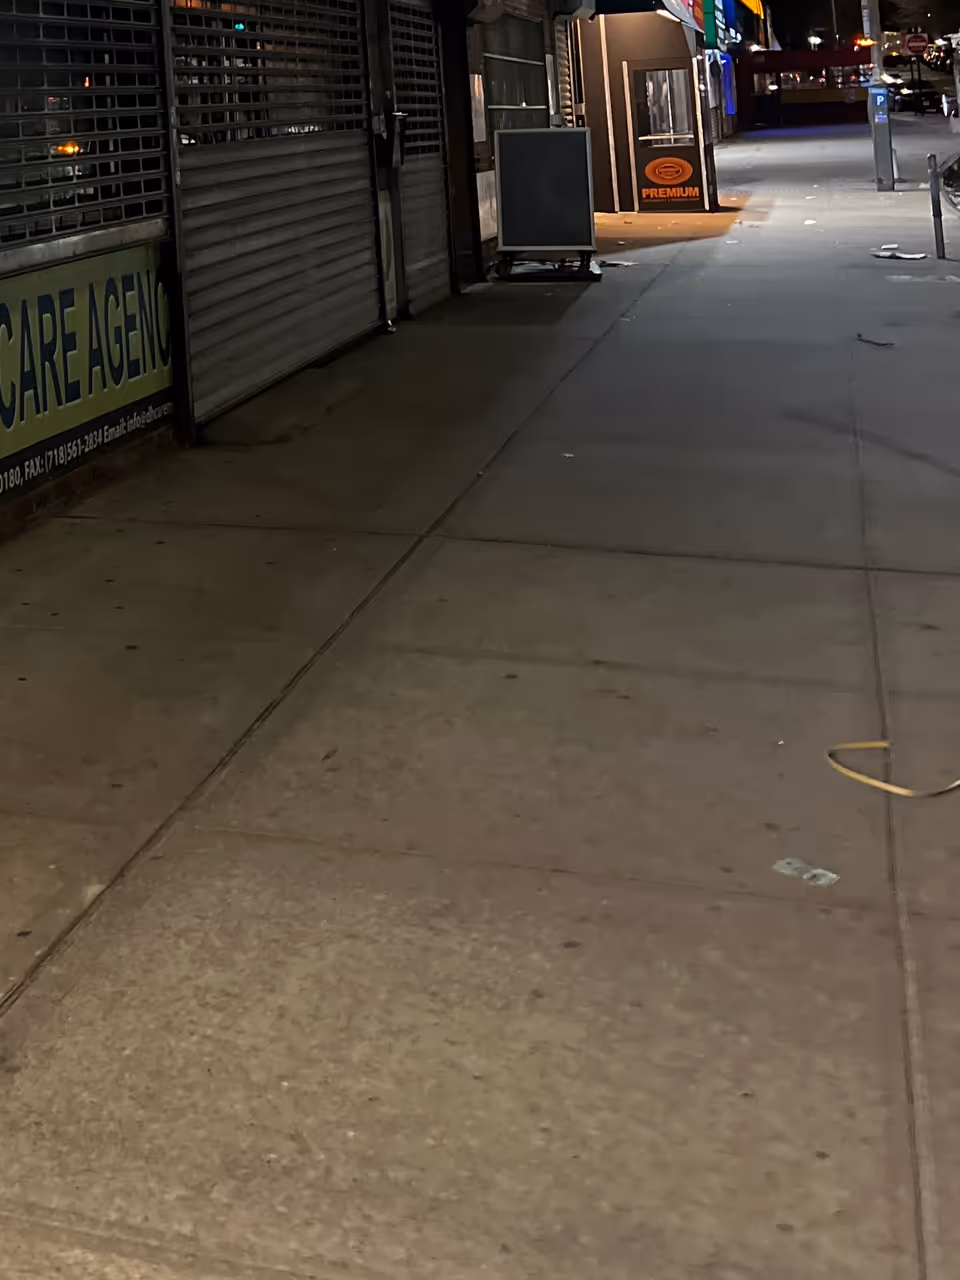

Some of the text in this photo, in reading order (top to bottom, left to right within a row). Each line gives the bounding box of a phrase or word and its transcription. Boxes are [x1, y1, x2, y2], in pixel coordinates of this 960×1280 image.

[640, 186, 700, 199] PREMIUM
[24, 455, 45, 482] FAX:
[103, 420, 126, 445] Email:
